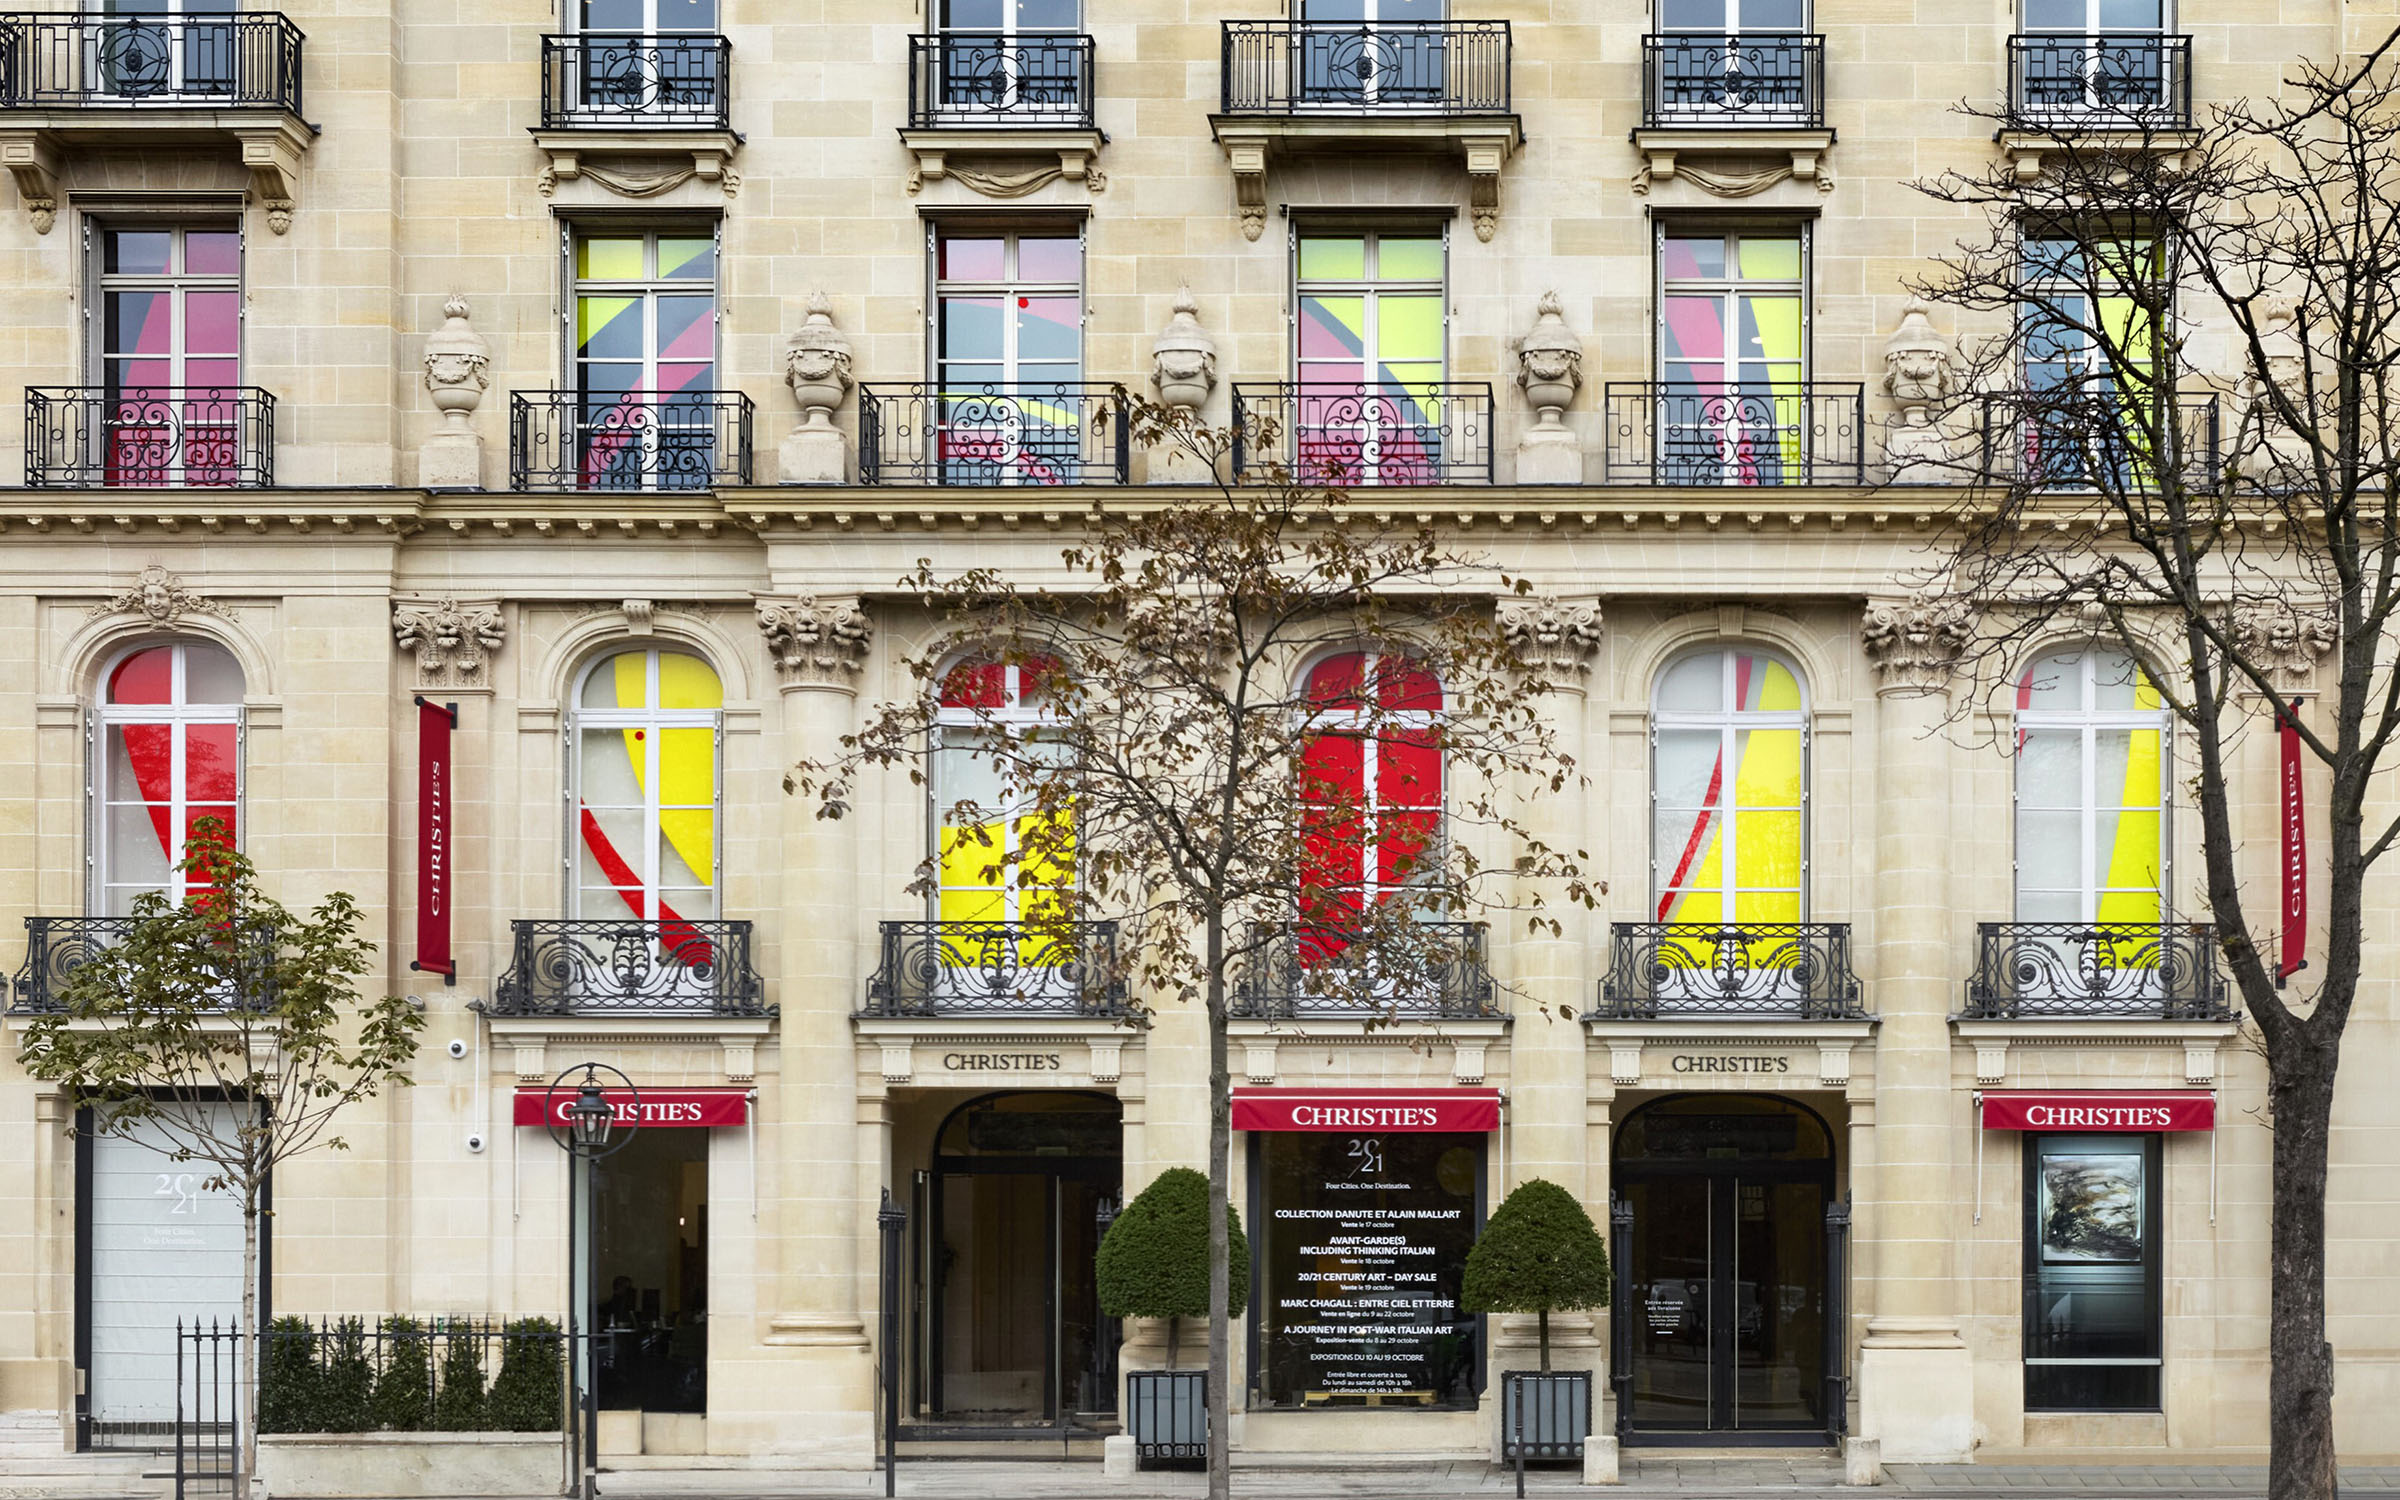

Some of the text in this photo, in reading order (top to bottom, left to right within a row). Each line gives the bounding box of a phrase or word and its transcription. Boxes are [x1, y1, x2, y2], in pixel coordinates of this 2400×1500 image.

[431, 761, 442, 917] CHRISTIE'S
[2288, 761, 2301, 917] CHRISTIE'S
[943, 1053, 1061, 1071] CHRISTIE'S
[1672, 1055, 1789, 1073] CHRISTIE'S
[1291, 1106, 1438, 1126] CHRISTIE'S
[2026, 1105, 2172, 1126] CHRISTIE'S
[1326, 1182, 1410, 1190] Four Cities. One Destination.
[1275, 1209, 1460, 1219] COLLECTION DANUTE ET ALAIN MALLART
[1330, 1236, 1406, 1246] AVANT-GARDE(S)
[1300, 1246, 1435, 1256] INCLUDING THINKING ITALIAN
[1340, 1257, 1357, 1265] Vente
[1298, 1272, 1321, 1281] 20/21
[1323, 1272, 1366, 1282] CENTURY
[1367, 1272, 1386, 1282] ART
[1395, 1273, 1413, 1282] DAY
[1415, 1272, 1436, 1282] SALE
[1282, 1299, 1308, 1308] MARC
[1310, 1299, 1352, 1308] CHAGALL
[1359, 1299, 1389, 1308] ENTRE
[1391, 1299, 1410, 1308] CIEL
[1413, 1299, 1424, 1308] ET
[1425, 1299, 1454, 1308] TERRE
[1347, 1310, 1360, 1319] ligne
[1284, 1325, 1453, 1335] A JOURNEY IN POST-WAR ITALIAN ART
[1316, 1336, 1364, 1344] Exposition-vente
[1311, 1353, 1353, 1361] EXPOSITIONS
[1355, 1353, 1364, 1361] DU
[1366, 1353, 1372, 1361] 10
[1392, 1354, 1423, 1362] OCTOBRE
